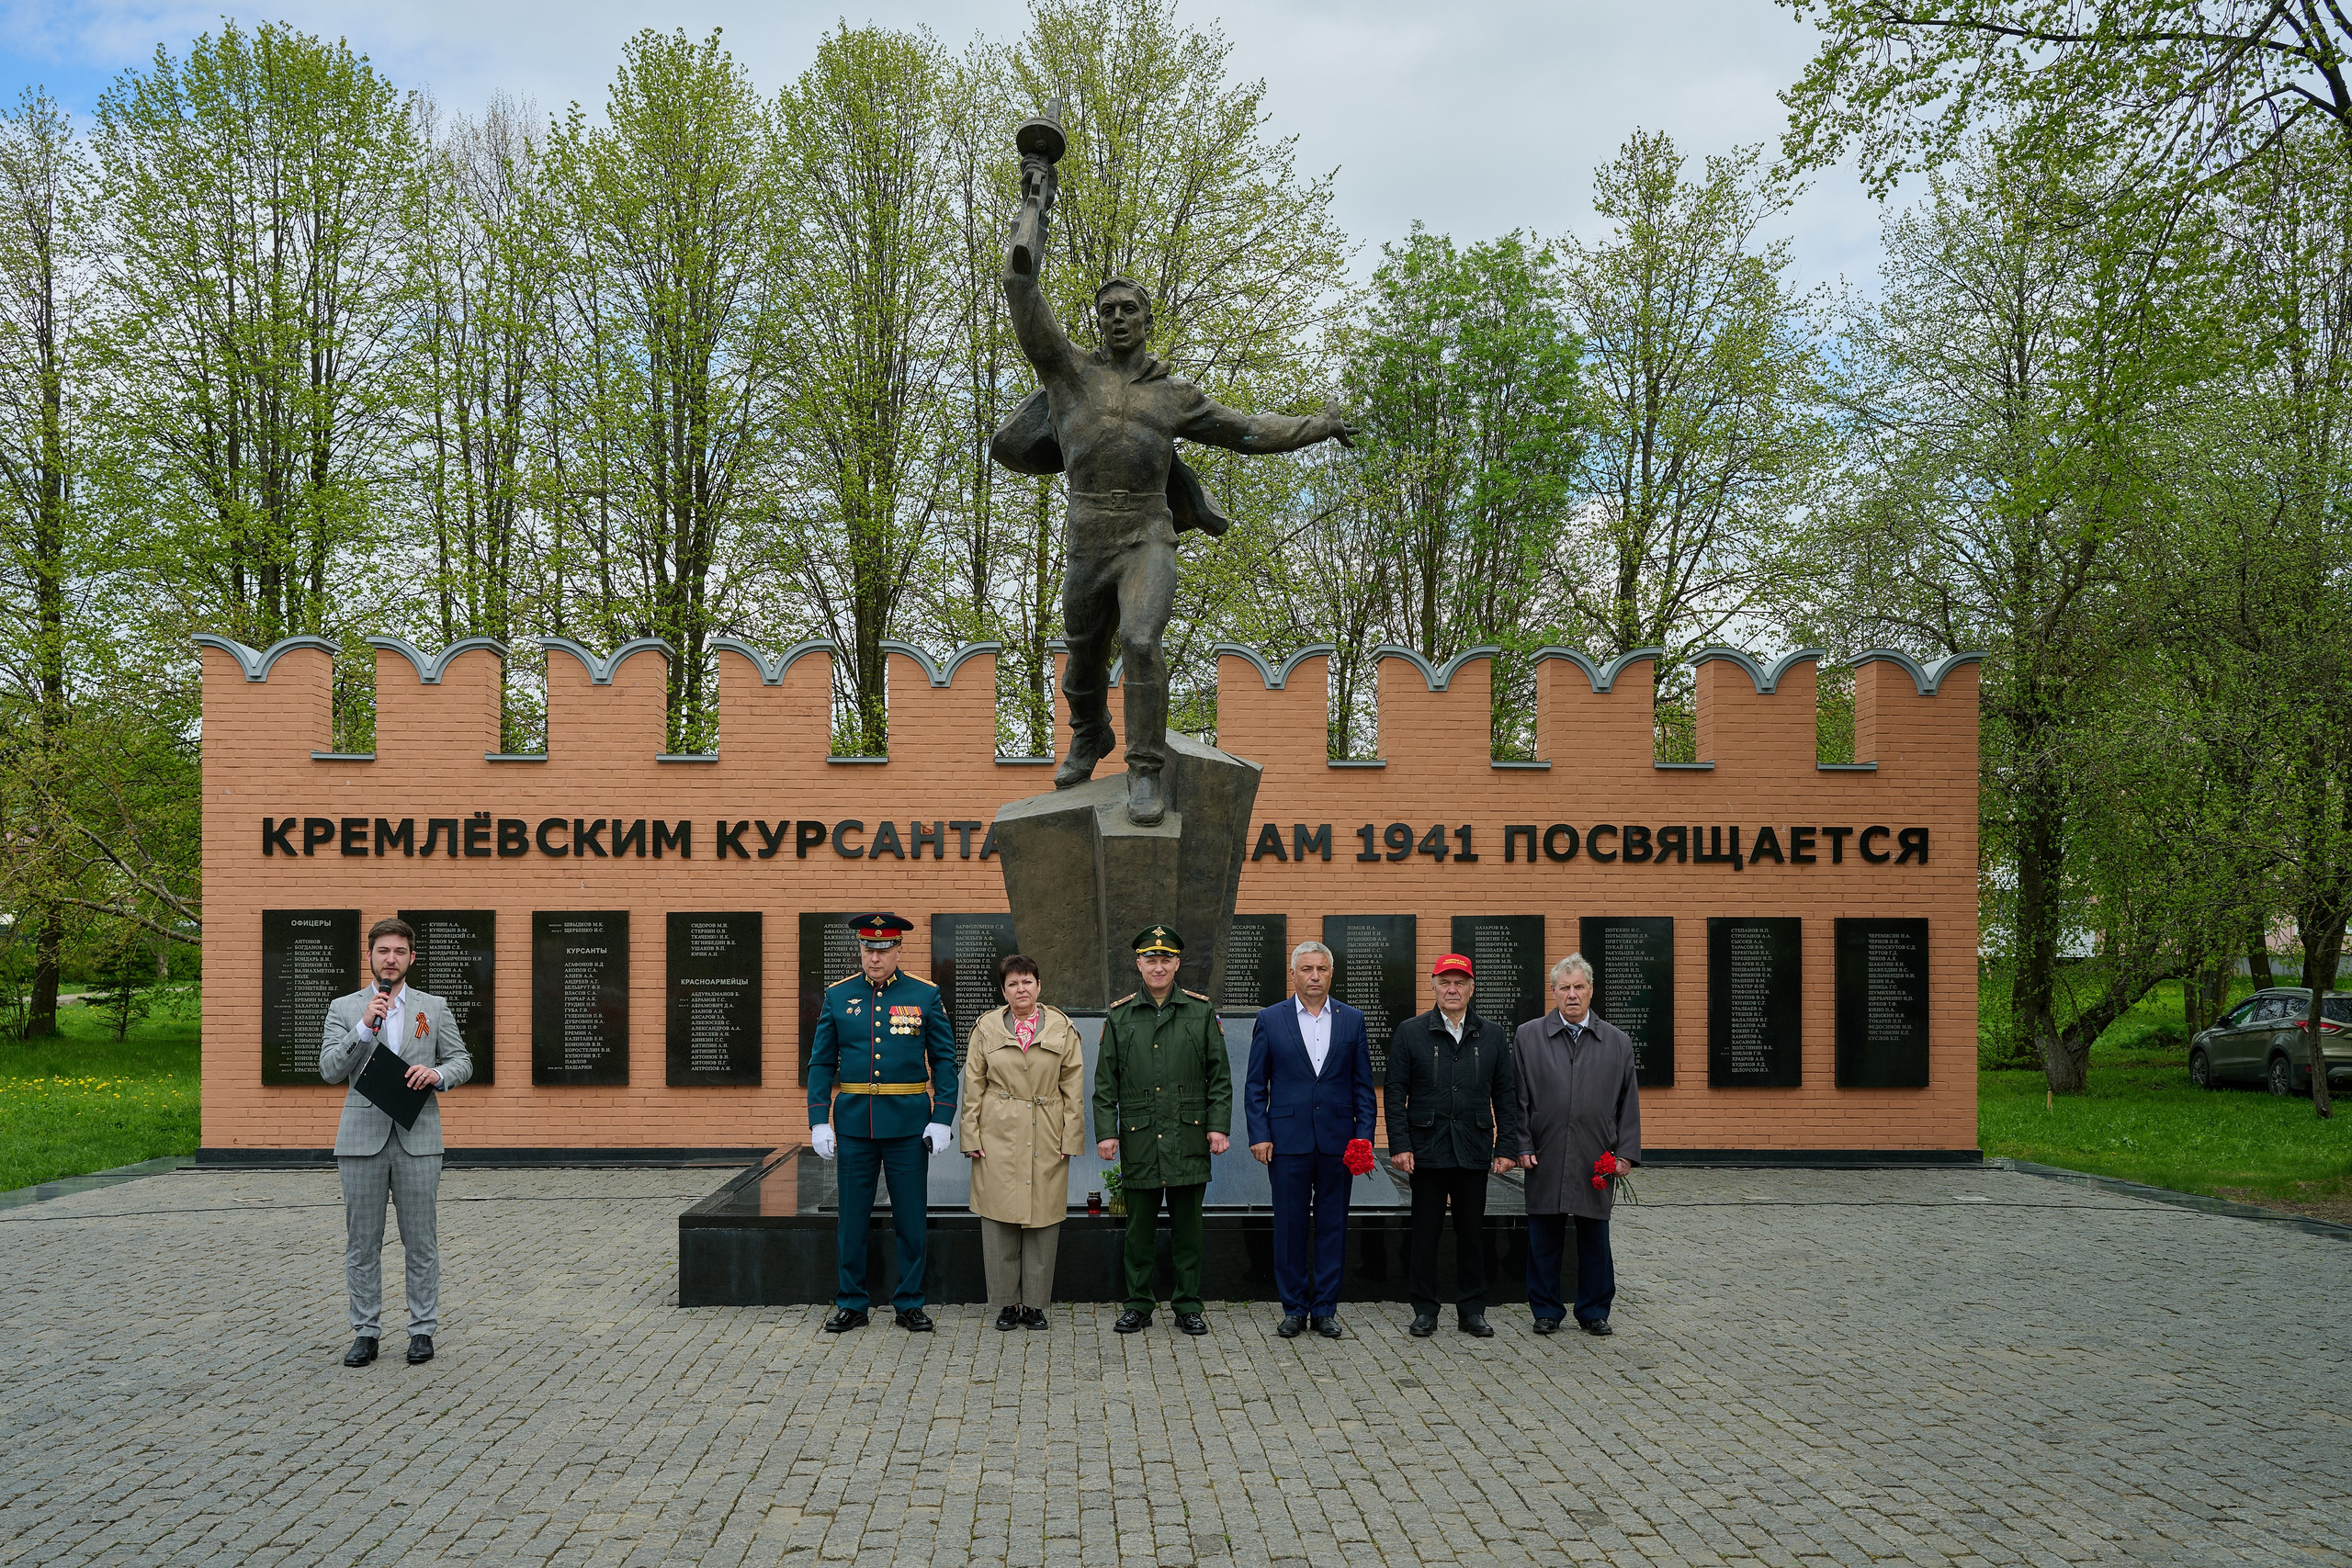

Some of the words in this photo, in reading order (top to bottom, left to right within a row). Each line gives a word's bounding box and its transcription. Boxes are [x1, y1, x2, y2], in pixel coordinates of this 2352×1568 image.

[262, 811, 691, 858] КРЕМЛЁВСКИМ
[1357, 823, 1479, 862] 1941
[1504, 824, 1930, 872] ПОСВЯЩАЕТСЯ
[680, 977, 749, 986] КРАСНОАРМЕЙЦЫ
